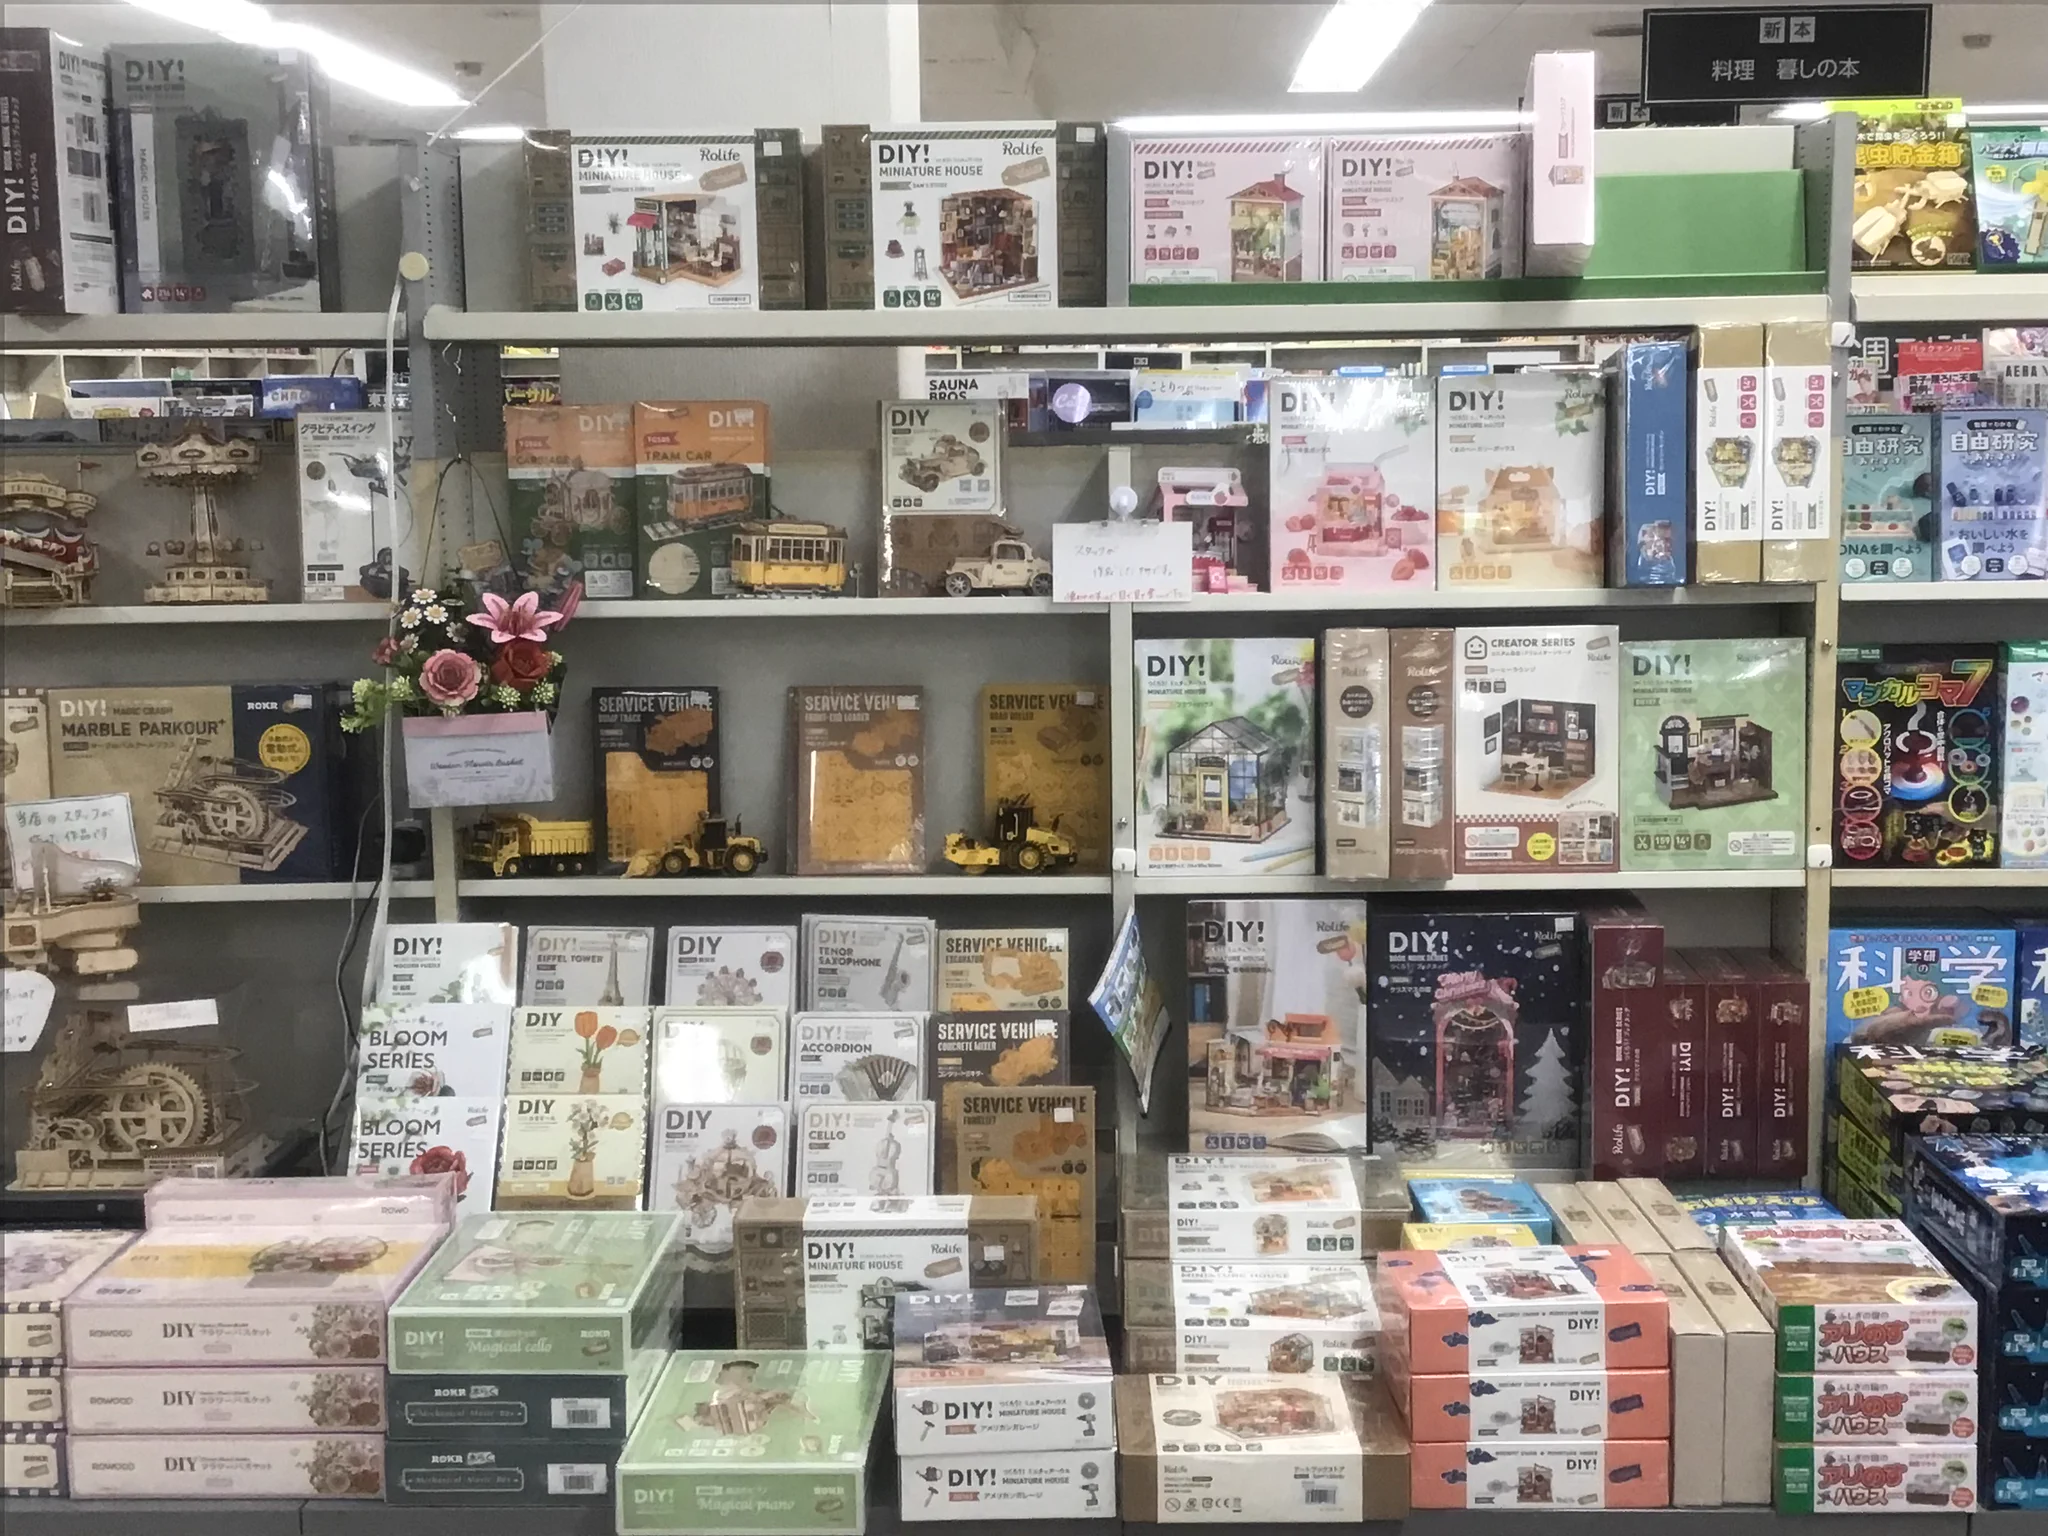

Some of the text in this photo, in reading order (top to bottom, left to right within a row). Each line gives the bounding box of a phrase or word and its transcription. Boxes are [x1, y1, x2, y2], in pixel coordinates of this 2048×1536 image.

[59, 50, 80, 73] DIY!
[1712, 57, 1860, 81] 料理 暮しの本
[125, 60, 185, 81] DIY!
[700, 149, 740, 162] Rolife
[878, 144, 930, 164] DIY!
[1002, 142, 1043, 155] Rolife
[578, 149, 628, 168] DIY!
[879, 165, 983, 177] MINIATURE HOUSE
[1144, 161, 1193, 179] DIY!
[1342, 158, 1392, 177] DIY!
[4, 178, 28, 233] DIY!
[1911, 345, 1971, 353] バックナンバー
[928, 378, 978, 392] SAUNA
[1449, 390, 1505, 412] DIY!
[578, 413, 626, 432] DIY!
[891, 409, 931, 427] DIY
[300, 422, 377, 436] グラビティスイング
[1843, 436, 1924, 456] 自由研究
[1951, 430, 2039, 451] 自由研究
[646, 450, 712, 461] TRAM CAR
[1644, 470, 1656, 496] DIY!
[1705, 500, 1717, 531] DIY!
[1772, 500, 1784, 531] DIY!
[1958, 528, 2028, 541] おいしい水を
[1972, 542, 2015, 554] 調べよう
[1491, 637, 1575, 648] CREATOR SERIES
[1147, 655, 1205, 677] DIY!
[1633, 654, 1691, 676] DIY!
[1842, 658, 1993, 708] マジカルコマ7
[60, 699, 107, 717] DIY!
[247, 701, 279, 711] ROKR
[599, 695, 714, 713] SERVICE VEHIE
[804, 696, 860, 711] SERVICE
[989, 694, 1046, 710] SERVICE
[61, 722, 131, 737] MARBLE
[818, 930, 857, 945] DIY!
[1204, 921, 1265, 942] DIY!
[393, 937, 442, 956] DIY!
[539, 937, 577, 951] DIY!
[678, 936, 723, 955] DIY
[946, 937, 1003, 953] SERVICE
[1389, 931, 1448, 953] DIY!
[537, 954, 603, 963] EIFFEL TOWER
[818, 947, 854, 956] TENOR
[818, 957, 881, 967] SAXOPHONE
[1836, 945, 1906, 994] 科
[1940, 945, 2008, 994] 学
[526, 1012, 562, 1027] DIY
[369, 1030, 448, 1047] BLOOM
[801, 1025, 842, 1040] DIY!
[937, 1021, 1058, 1040] SERVICE VEHIE
[801, 1043, 873, 1053] ACCORDION
[367, 1053, 435, 1070] SERIES
[1679, 1042, 1692, 1072] DIY!
[1615, 1067, 1631, 1108] DIY!
[518, 1099, 556, 1114] DIY
[963, 1096, 1023, 1114] SERVICE
[1722, 1088, 1735, 1118] DIY!
[1774, 1088, 1786, 1118] DIY!
[361, 1119, 441, 1136] BLOOM
[666, 1110, 713, 1130] DIY
[809, 1112, 850, 1129] DIY!
[808, 1130, 847, 1141] CELLO
[1612, 1124, 1624, 1155] Rolife
[358, 1142, 428, 1159] SERIES
[1175, 1157, 1225, 1165] DIY!
[1177, 1219, 1199, 1227] DIY!
[808, 1242, 855, 1260] DIY!
[931, 1243, 962, 1255] Rolife
[808, 1260, 903, 1271] MINIATURE HOUSE
[1181, 1265, 1233, 1273] DIY!
[909, 1293, 974, 1305] DIY!
[162, 1323, 197, 1339] DIY
[1568, 1318, 1599, 1330] DIY!
[1818, 1319, 1909, 1346] アリのす
[404, 1330, 445, 1346] DIY!
[1184, 1335, 1207, 1344] DIY!
[1833, 1345, 1888, 1364] ハウス
[1155, 1375, 1223, 1386] DIY
[89, 1397, 134, 1405] ROWOOD
[162, 1390, 197, 1406] DIY
[1569, 1389, 1600, 1401] DIY!
[944, 1401, 993, 1420] DIY!
[999, 1408, 1067, 1417] MINIATURE HOUSE
[1818, 1391, 1909, 1418] アリのす
[1833, 1416, 1888, 1436] ハウス
[92, 1462, 135, 1471] ROWOOD
[164, 1456, 198, 1472] DIY
[1566, 1459, 1597, 1470] DIY!
[948, 1469, 997, 1487] DIY!
[1818, 1462, 1909, 1489] アリのす
[634, 1488, 674, 1504] DIY!
[1833, 1487, 1888, 1507] ハウス
